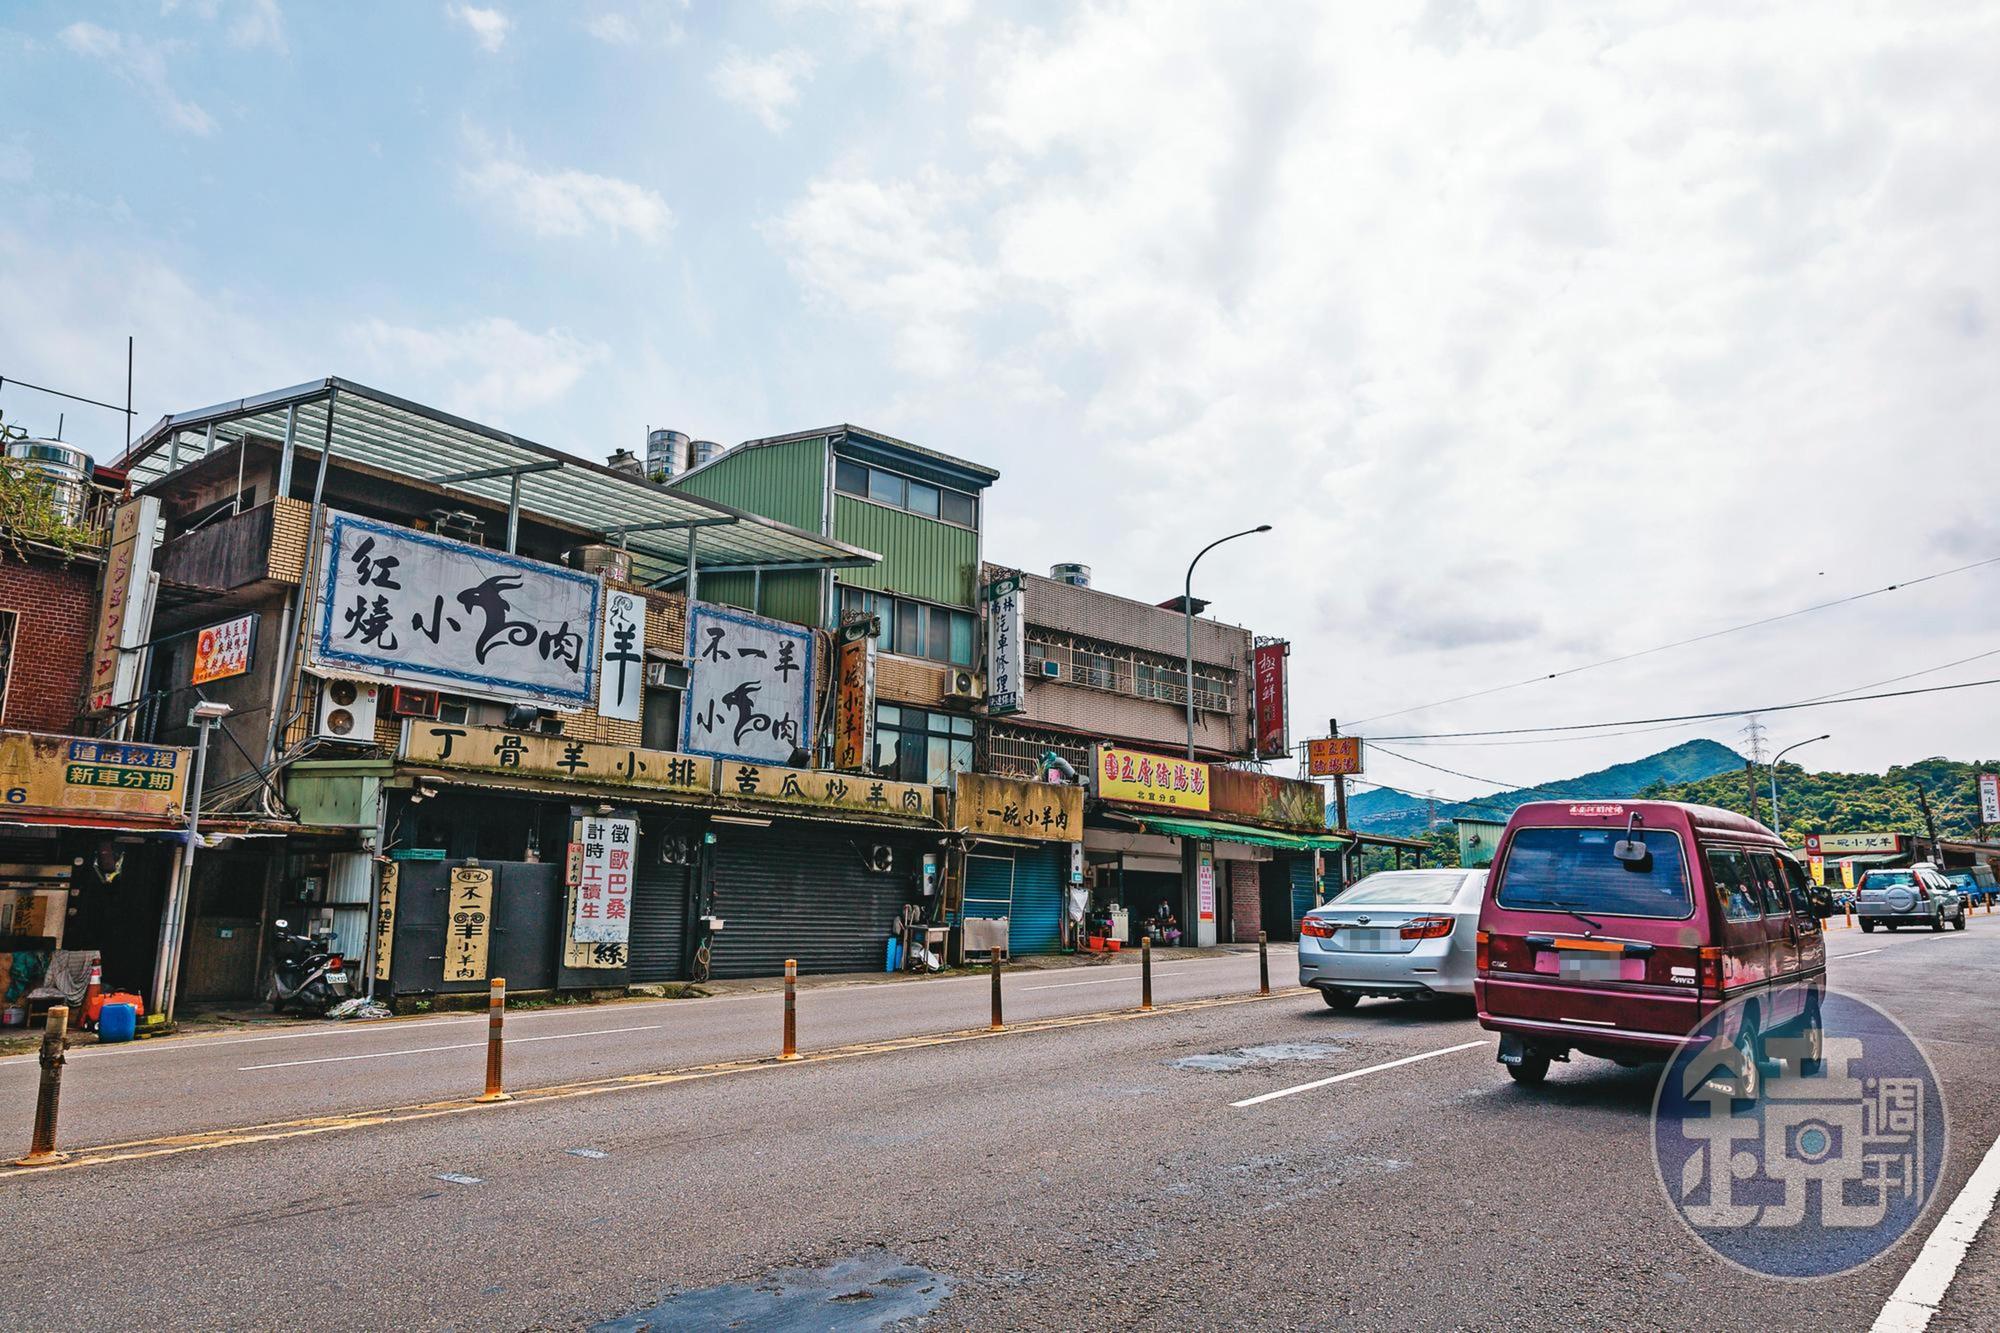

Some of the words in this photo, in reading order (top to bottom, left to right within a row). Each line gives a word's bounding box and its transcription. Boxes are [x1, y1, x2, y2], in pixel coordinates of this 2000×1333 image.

[344, 536, 401, 651] 紅燒
[605, 622, 642, 707] 羊
[701, 627, 800, 684] 不一羊
[70, 767, 172, 790] 新車分期
[429, 728, 697, 788] 丁骨羊小排
[735, 766, 923, 815] 苦瓜炒羊肉
[986, 801, 1069, 832] 一碗小羊肉
[461, 872, 484, 880] 好吃
[581, 823, 606, 919] 計時工讀生
[606, 823, 630, 920] 徵歐巴桑
[1670, 975, 1695, 984] 4WD
[1500, 1054, 1521, 1063] 4WD
